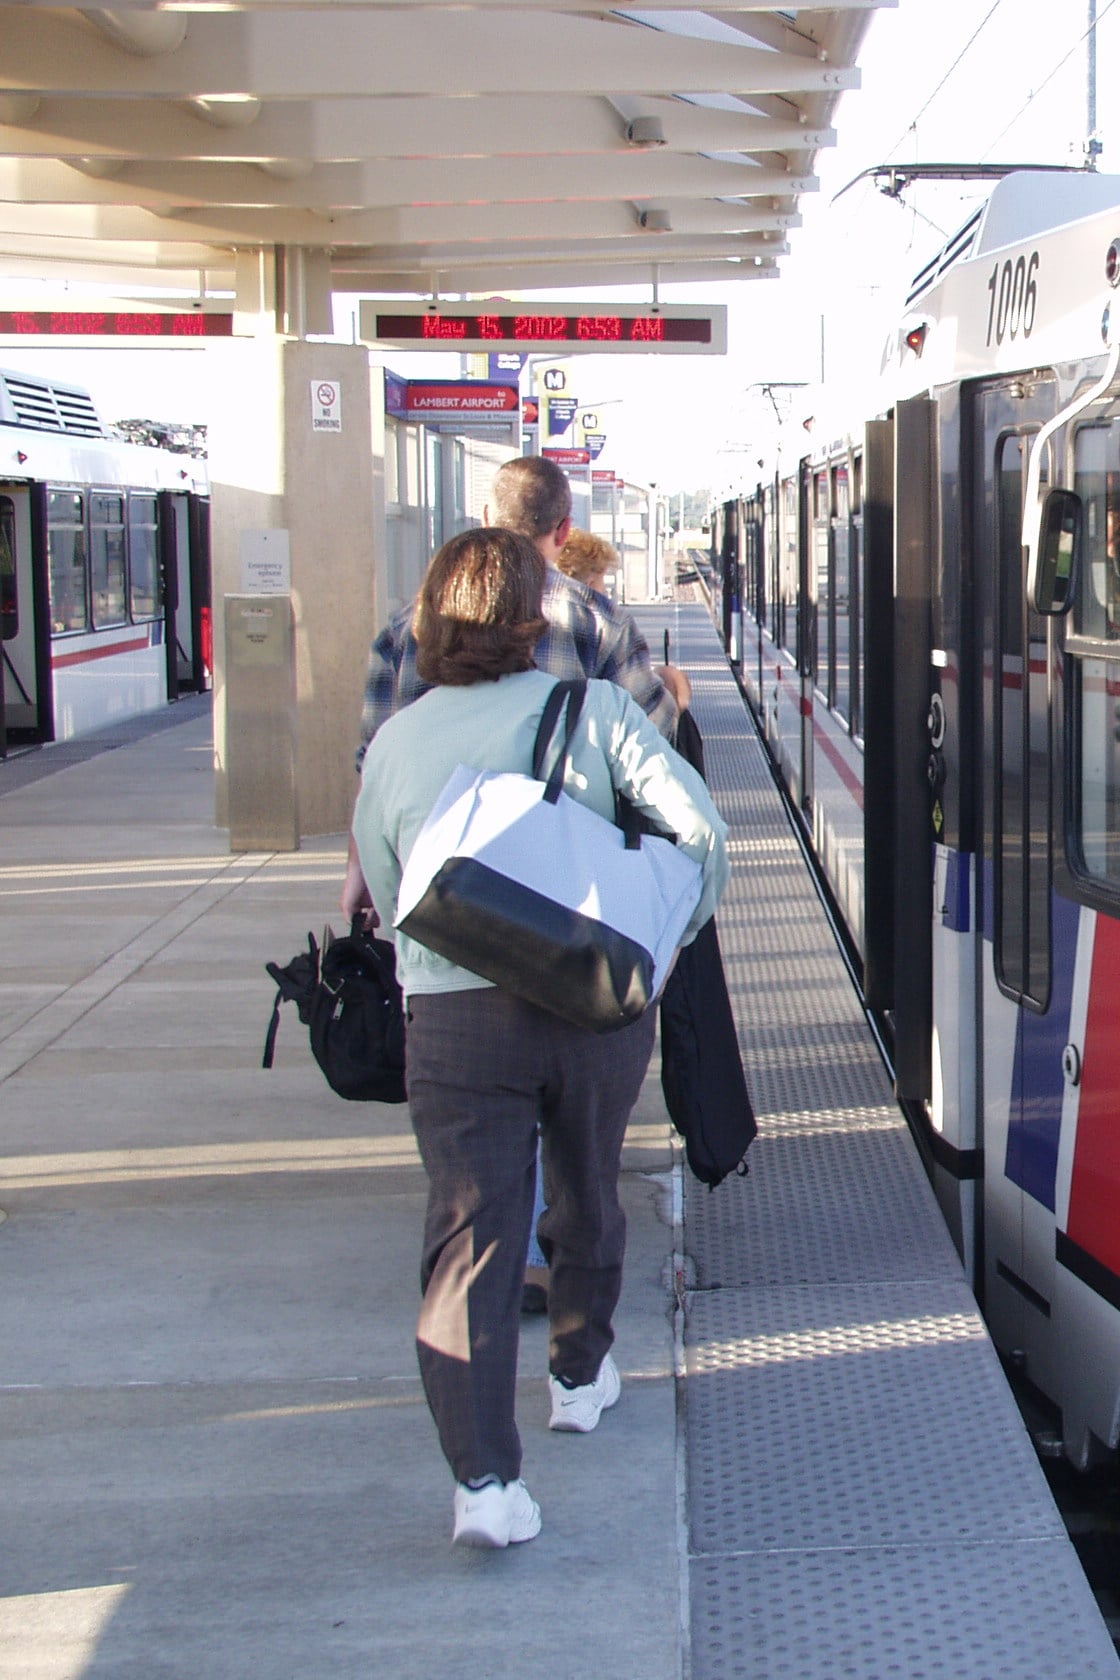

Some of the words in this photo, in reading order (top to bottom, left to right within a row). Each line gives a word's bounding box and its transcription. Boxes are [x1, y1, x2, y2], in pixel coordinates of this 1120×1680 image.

[986, 250, 1039, 347] 1006
[423, 313, 467, 340] May
[513, 314, 568, 341] 2002
[631, 315, 664, 342] AM
[546, 371, 564, 389] M
[413, 396, 459, 408] LAMBERT
[461, 397, 507, 409] AIRPORT
[322, 408, 331, 417] NO
[314, 419, 340, 428] SMOKING
